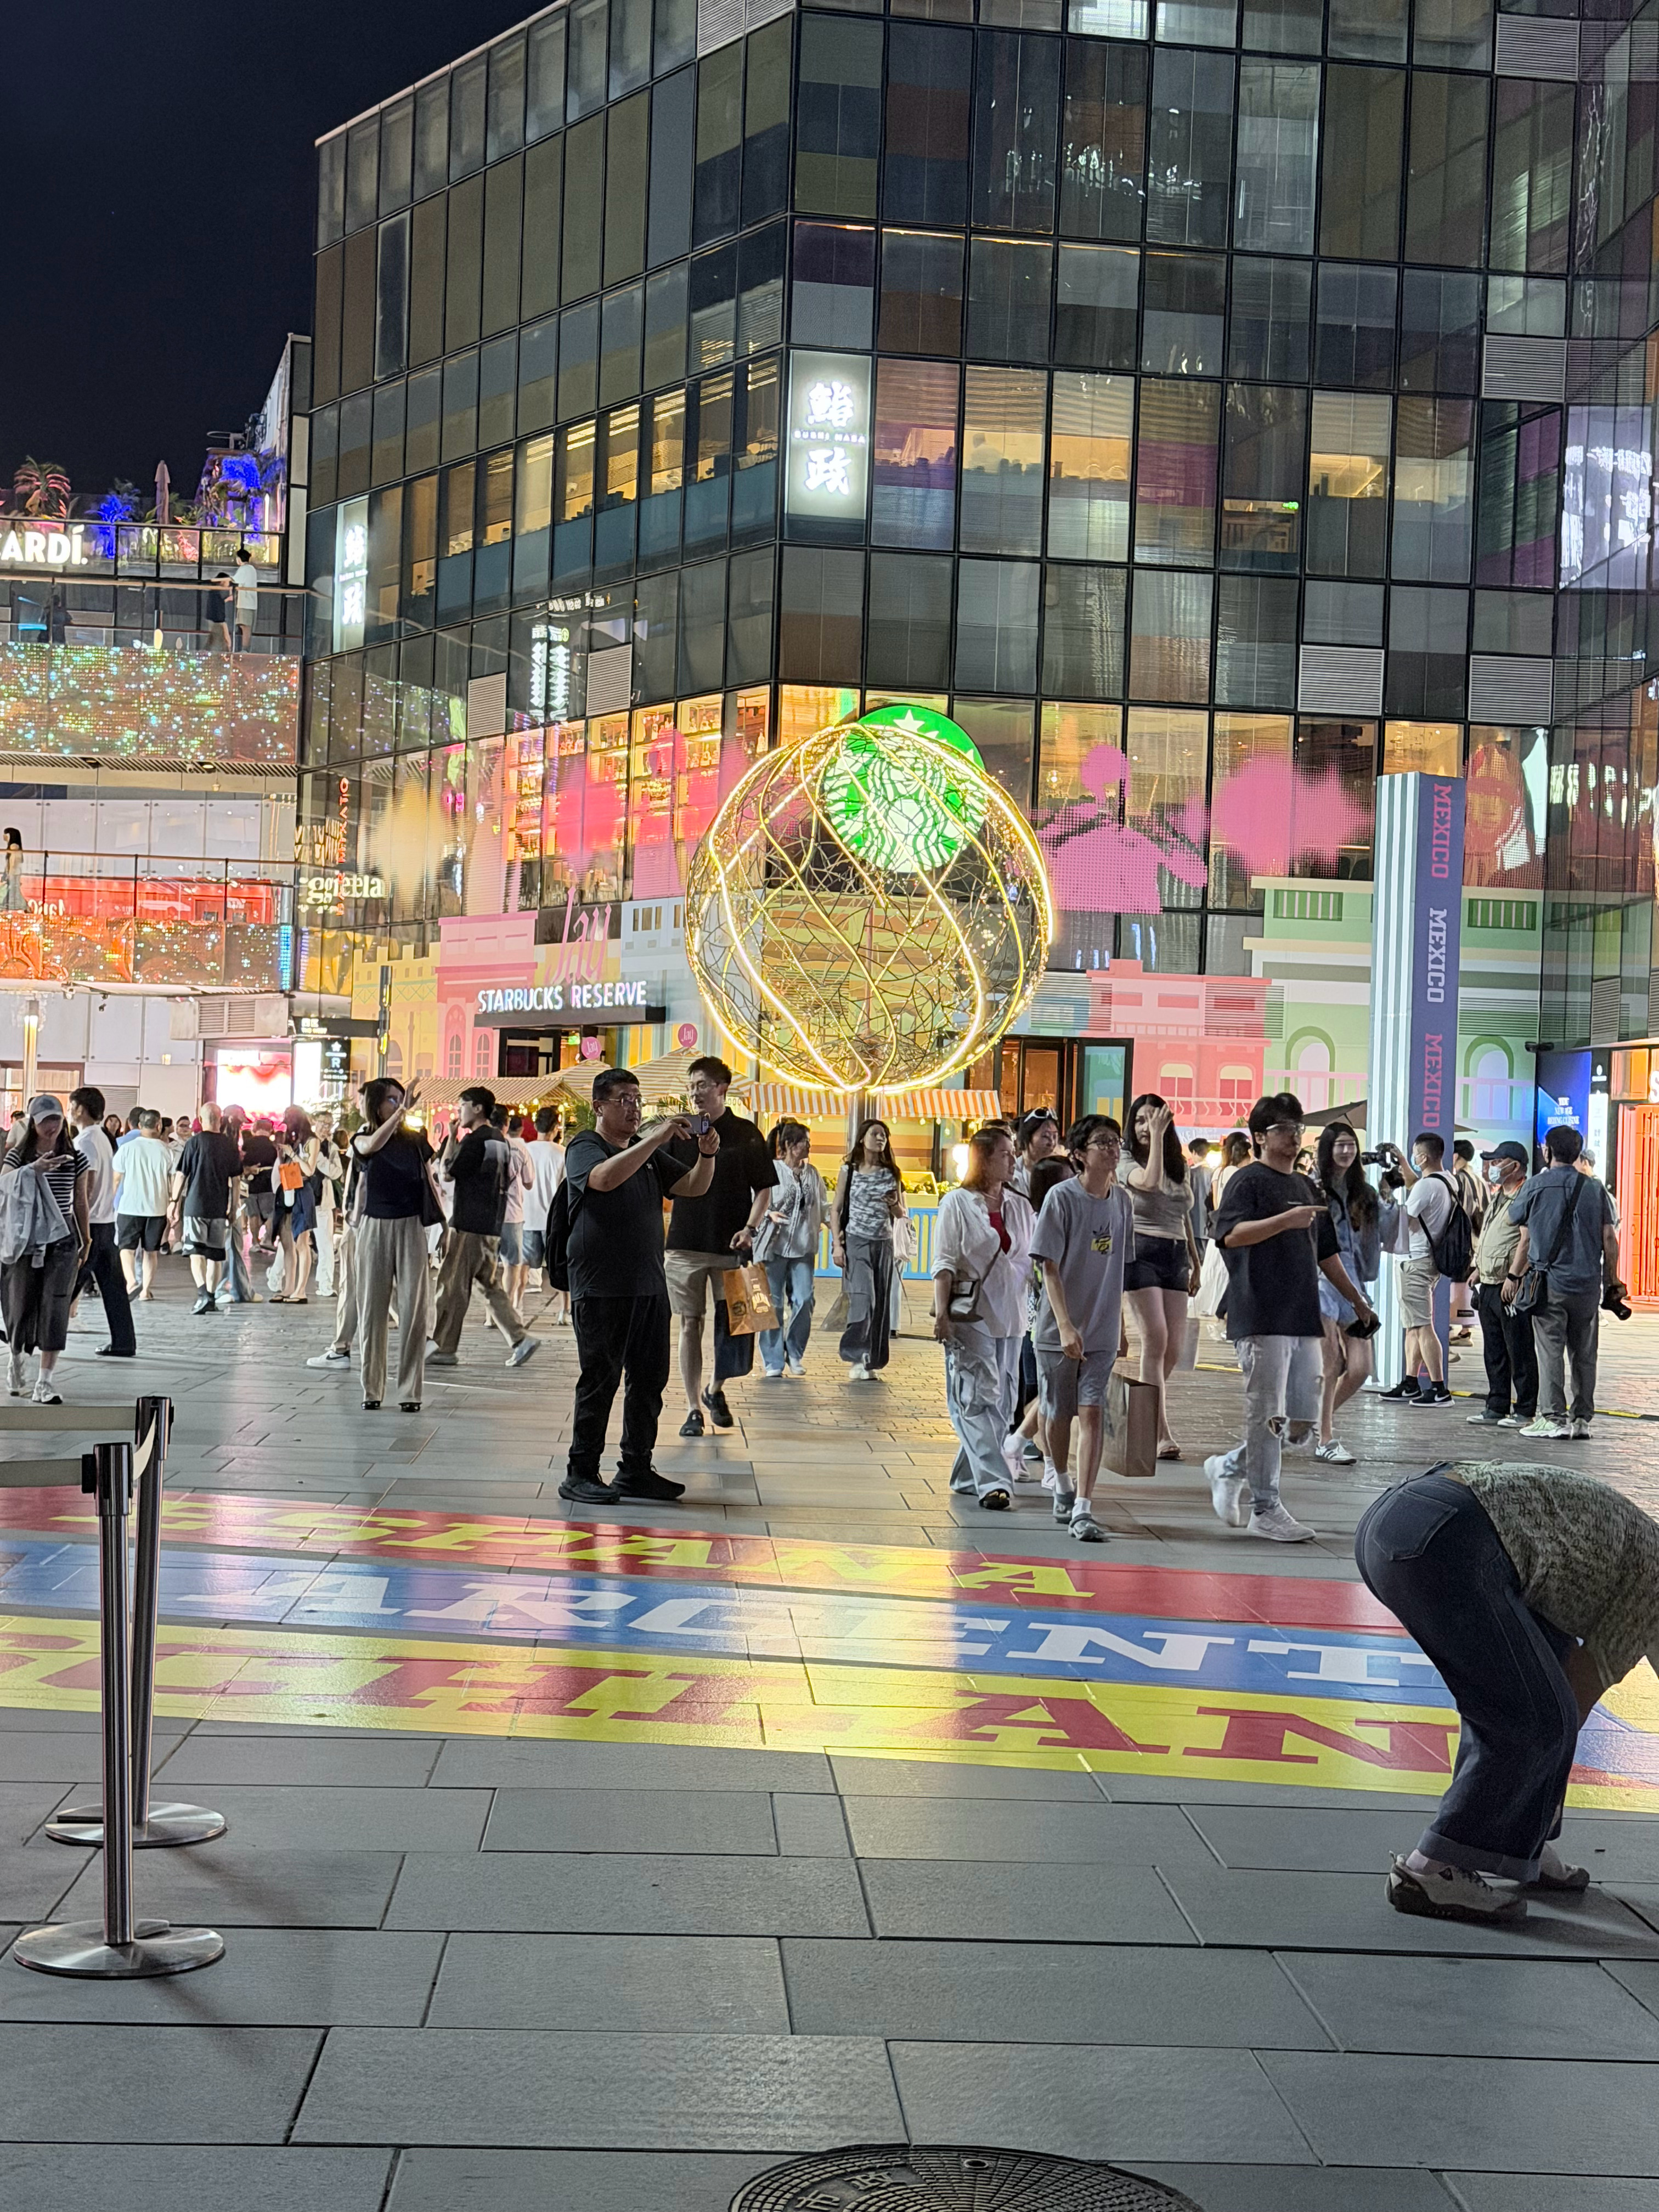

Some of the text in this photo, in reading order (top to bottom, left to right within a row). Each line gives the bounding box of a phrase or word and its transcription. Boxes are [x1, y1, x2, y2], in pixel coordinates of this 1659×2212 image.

[1431, 783, 1452, 879] MEXICO
[477, 980, 647, 1013] STARBUCKS RESERVE
[1427, 908, 1447, 1003] MEXICO
[1422, 1033, 1442, 1128] MEXICO
[177, 1572, 1436, 1686] ARGENT
